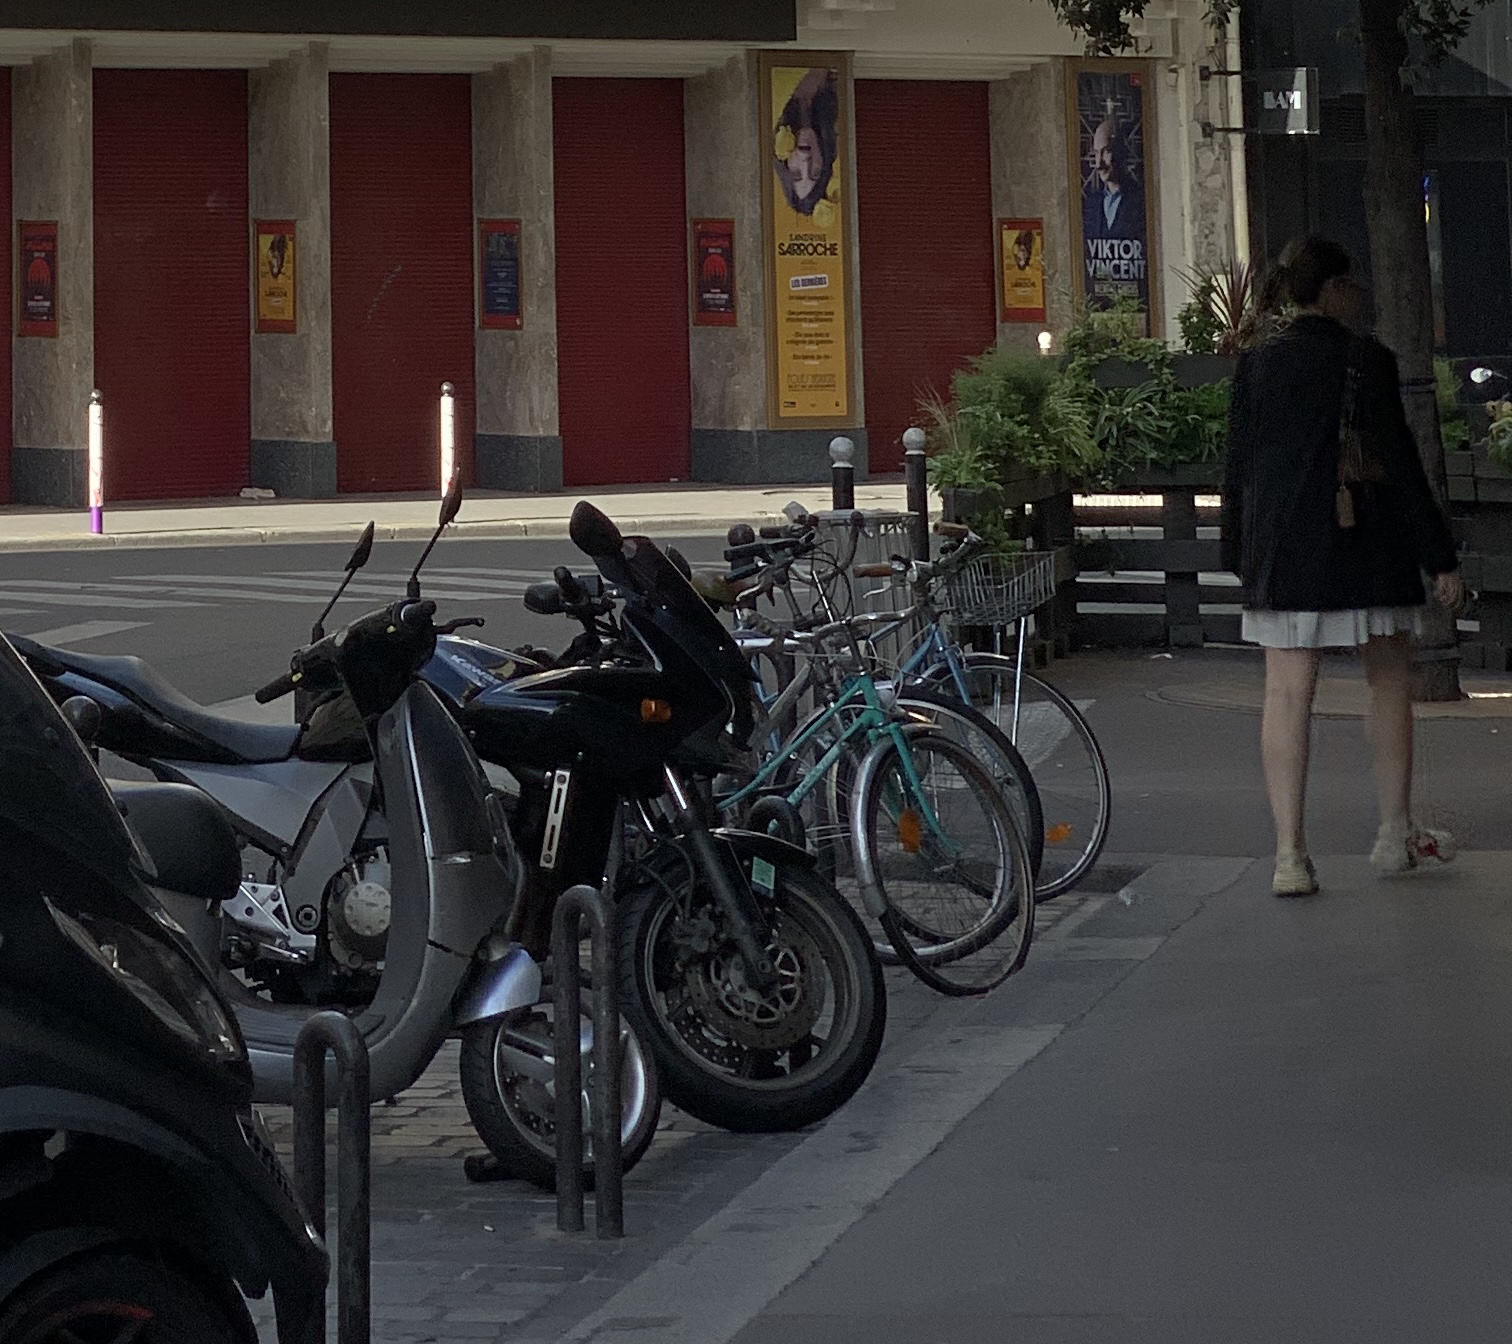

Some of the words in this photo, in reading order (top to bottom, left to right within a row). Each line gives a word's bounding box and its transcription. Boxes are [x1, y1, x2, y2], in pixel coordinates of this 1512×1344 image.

[777, 242, 839, 257] SARROCHE
[1087, 238, 1142, 259] VIKTOR
[1085, 258, 1146, 280] VINCENT
